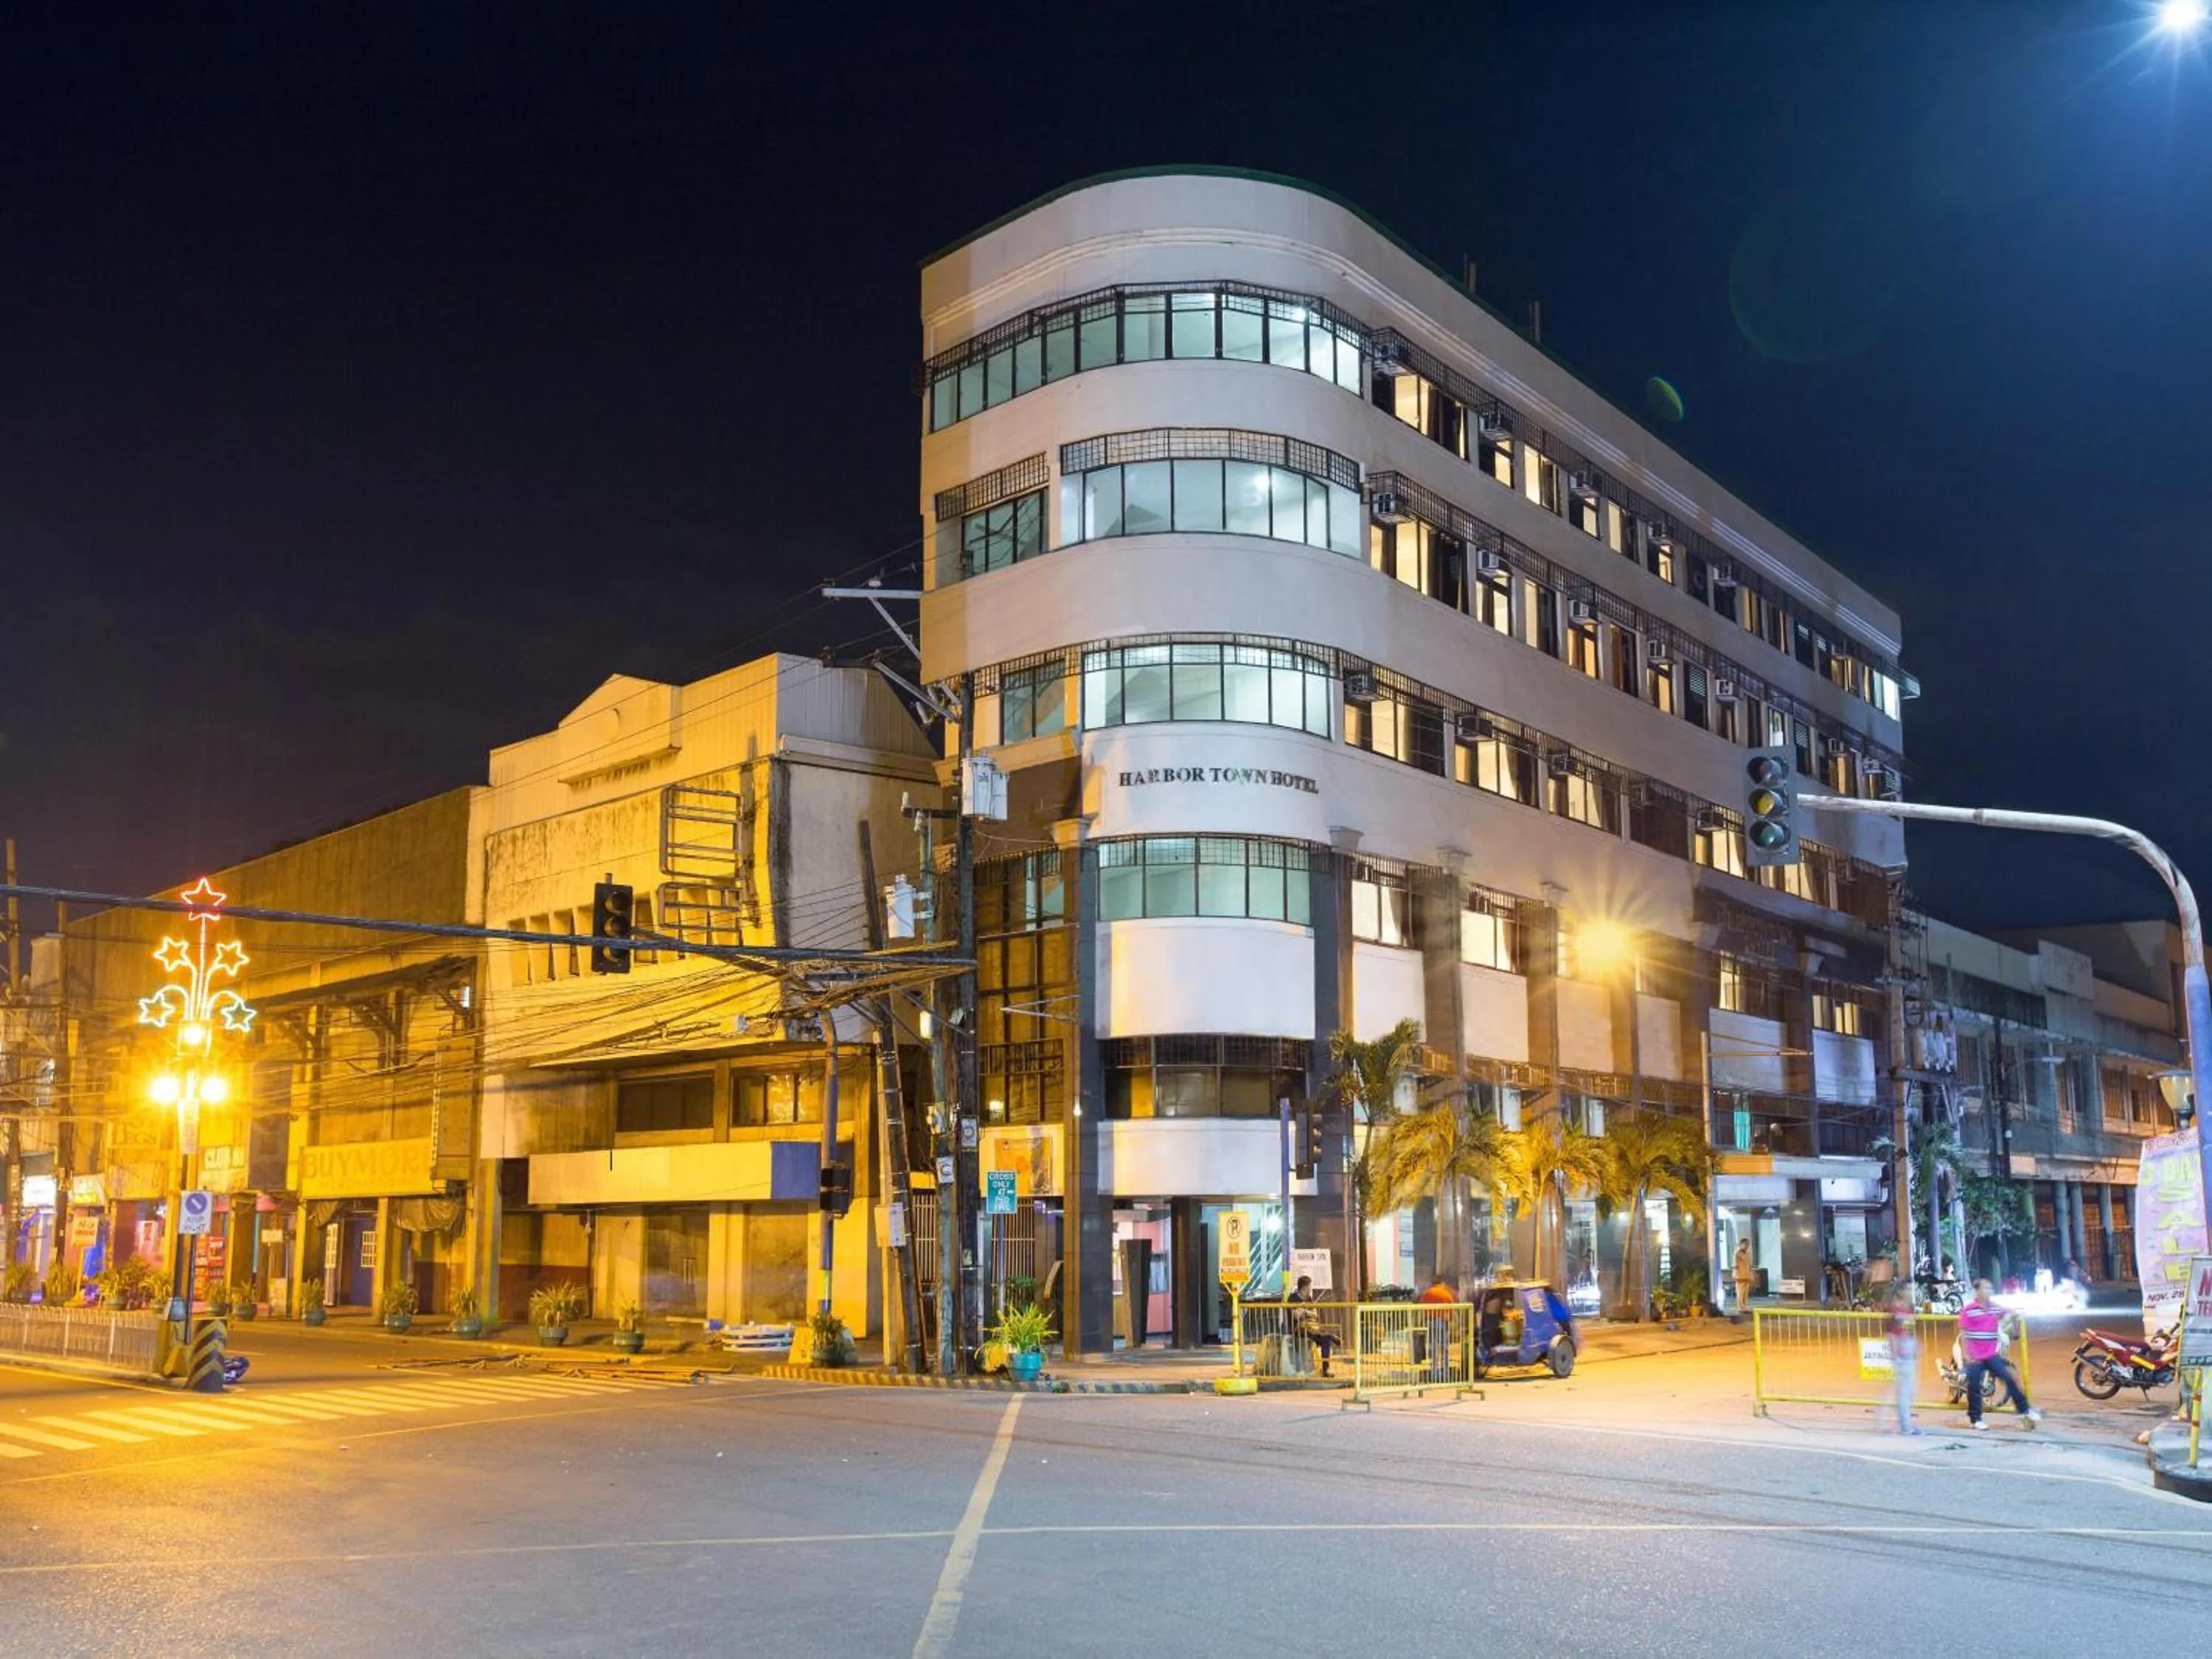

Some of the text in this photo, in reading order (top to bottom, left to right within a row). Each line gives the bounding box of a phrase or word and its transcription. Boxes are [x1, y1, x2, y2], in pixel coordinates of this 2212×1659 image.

[1119, 768, 1319, 794] HARBOR TOWN HOTEL
